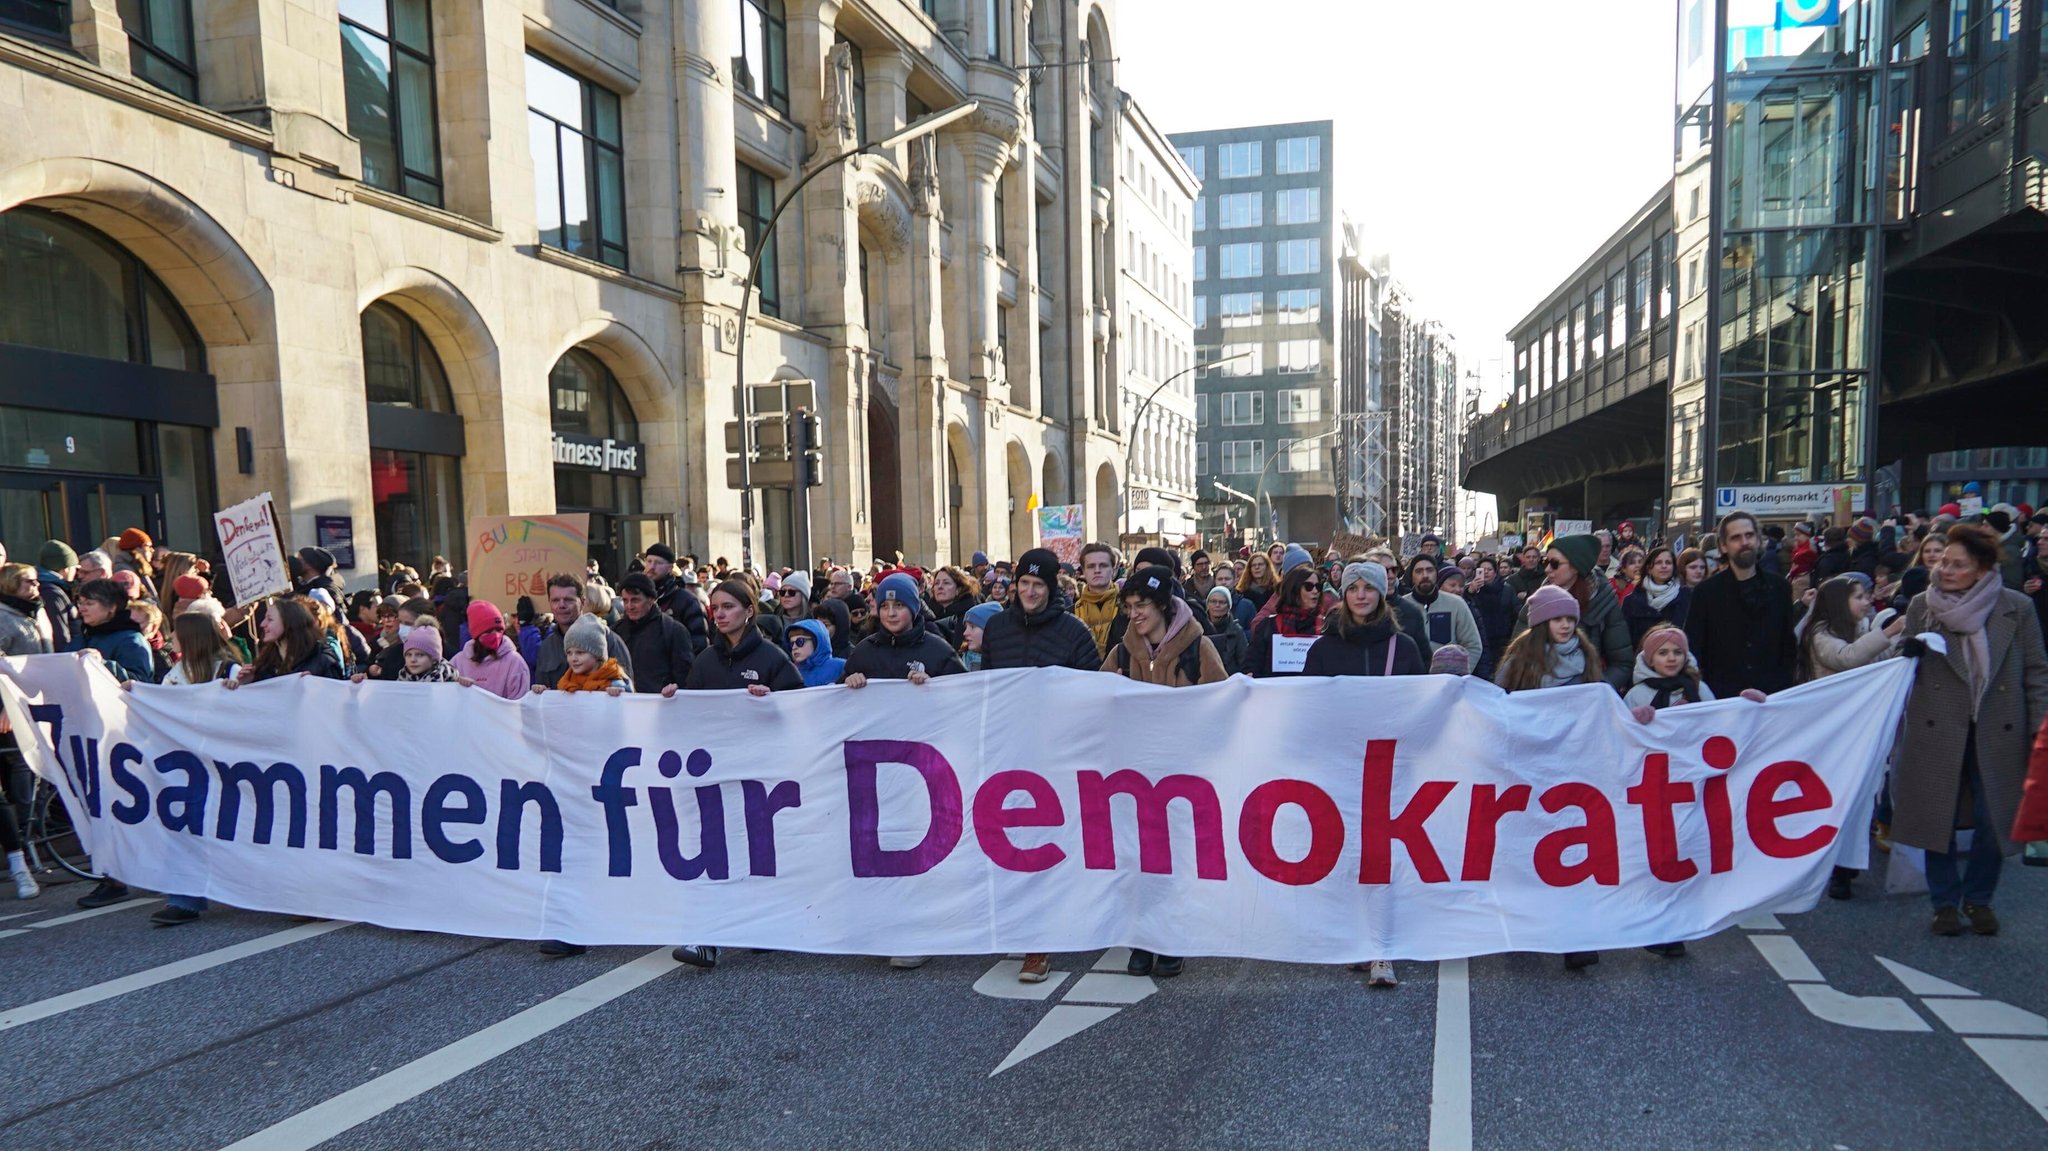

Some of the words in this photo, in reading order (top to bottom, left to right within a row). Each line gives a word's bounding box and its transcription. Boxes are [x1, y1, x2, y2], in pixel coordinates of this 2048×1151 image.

[65, 436, 75, 454] 9
[552, 432, 602, 467] itness
[602, 439, 637, 471] First
[1131, 490, 1149, 500] FOTO
[1742, 491, 1818, 505] Rödingsmarkt
[220, 516, 254, 546] Denke
[480, 520, 536, 554] BUNT
[28, 704, 564, 874] Zusammen
[592, 748, 801, 881] für
[844, 736, 1838, 887] Demokratie
